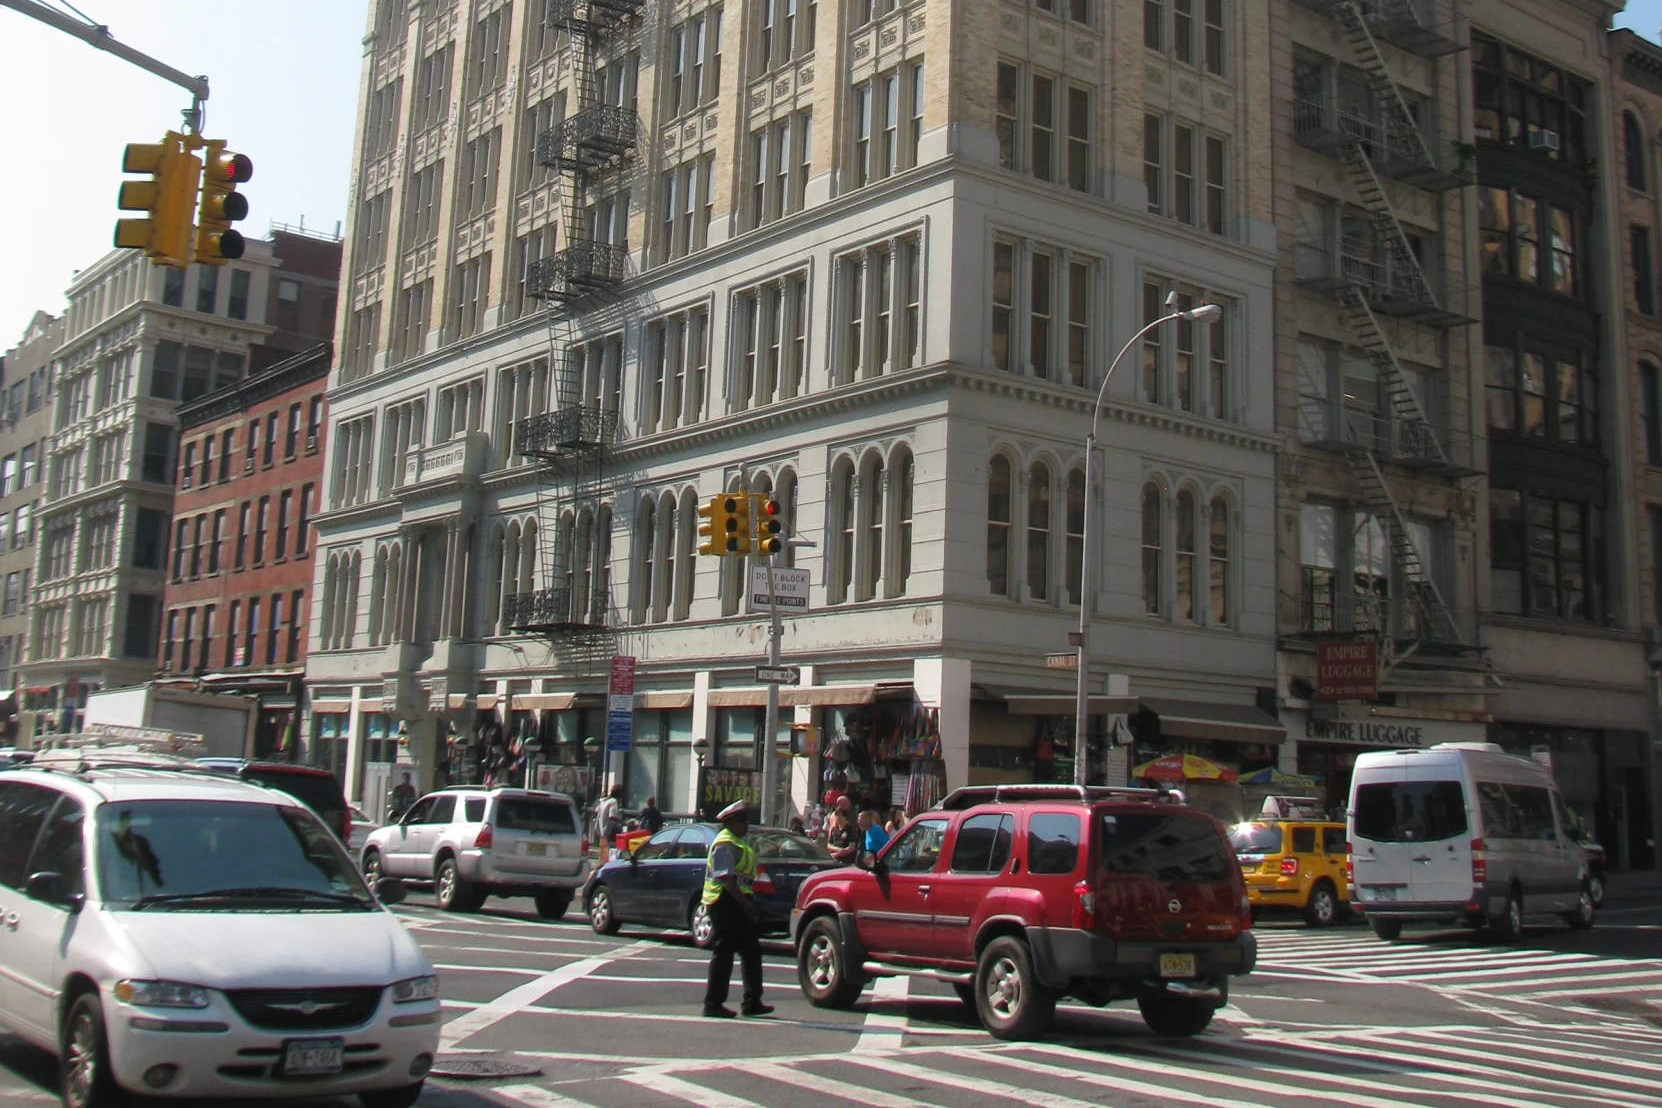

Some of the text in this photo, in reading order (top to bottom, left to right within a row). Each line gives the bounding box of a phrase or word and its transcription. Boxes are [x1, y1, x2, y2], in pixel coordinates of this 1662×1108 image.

[780, 574, 806, 583] BLOCK
[765, 582, 797, 592] TE BOX
[1326, 645, 1369, 660] EMPIRE
[1047, 655, 1077, 667] CANAL ST
[761, 671, 794, 680] ONE WAY
[1321, 664, 1374, 678] LUGGAGE
[1305, 719, 1422, 745] EMPIRE LUGGAGE
[705, 784, 761, 804] SAVAGE
